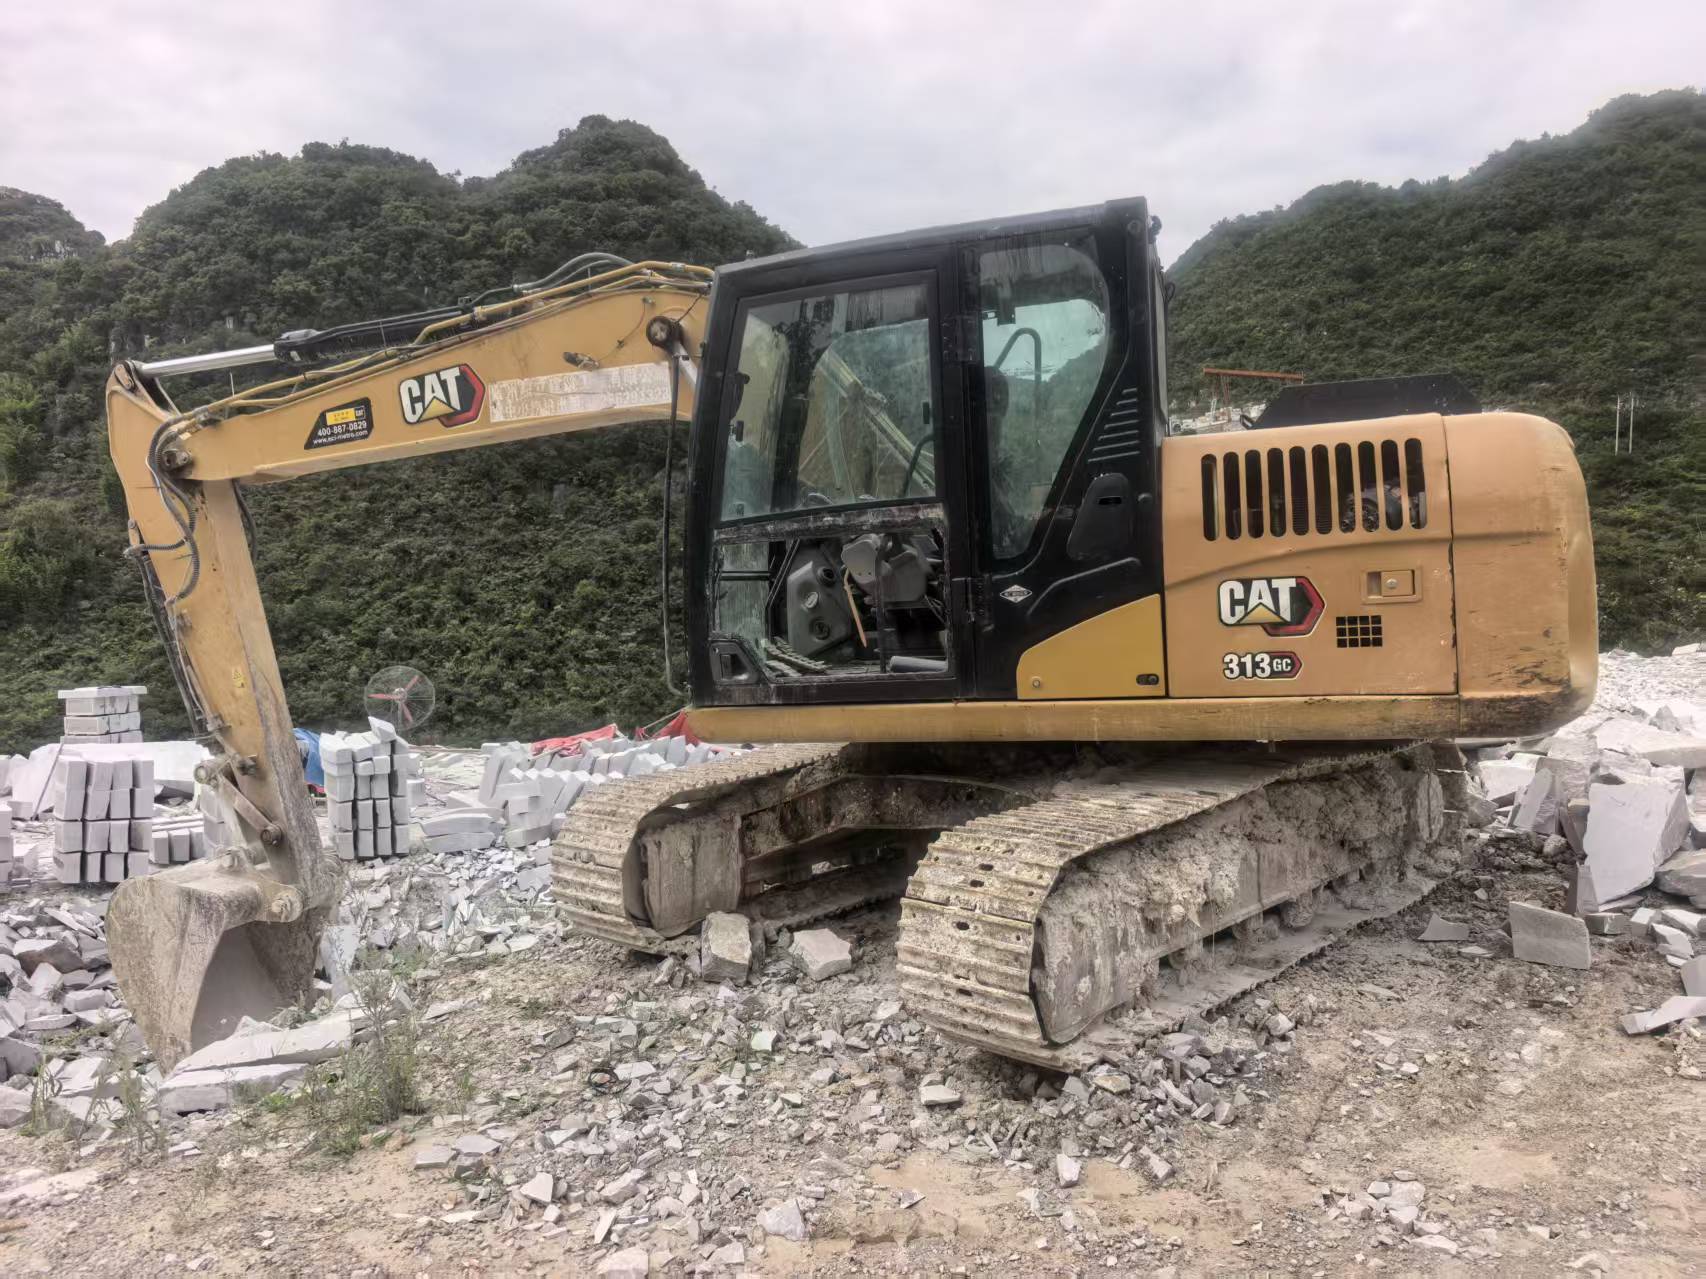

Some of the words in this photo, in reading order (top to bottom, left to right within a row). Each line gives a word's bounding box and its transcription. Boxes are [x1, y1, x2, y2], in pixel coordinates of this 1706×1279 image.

[400, 366, 461, 423] CAT
[317, 420, 367, 437] 400-887-0829
[1219, 577, 1297, 625] CAT
[1223, 652, 1271, 679] 313
